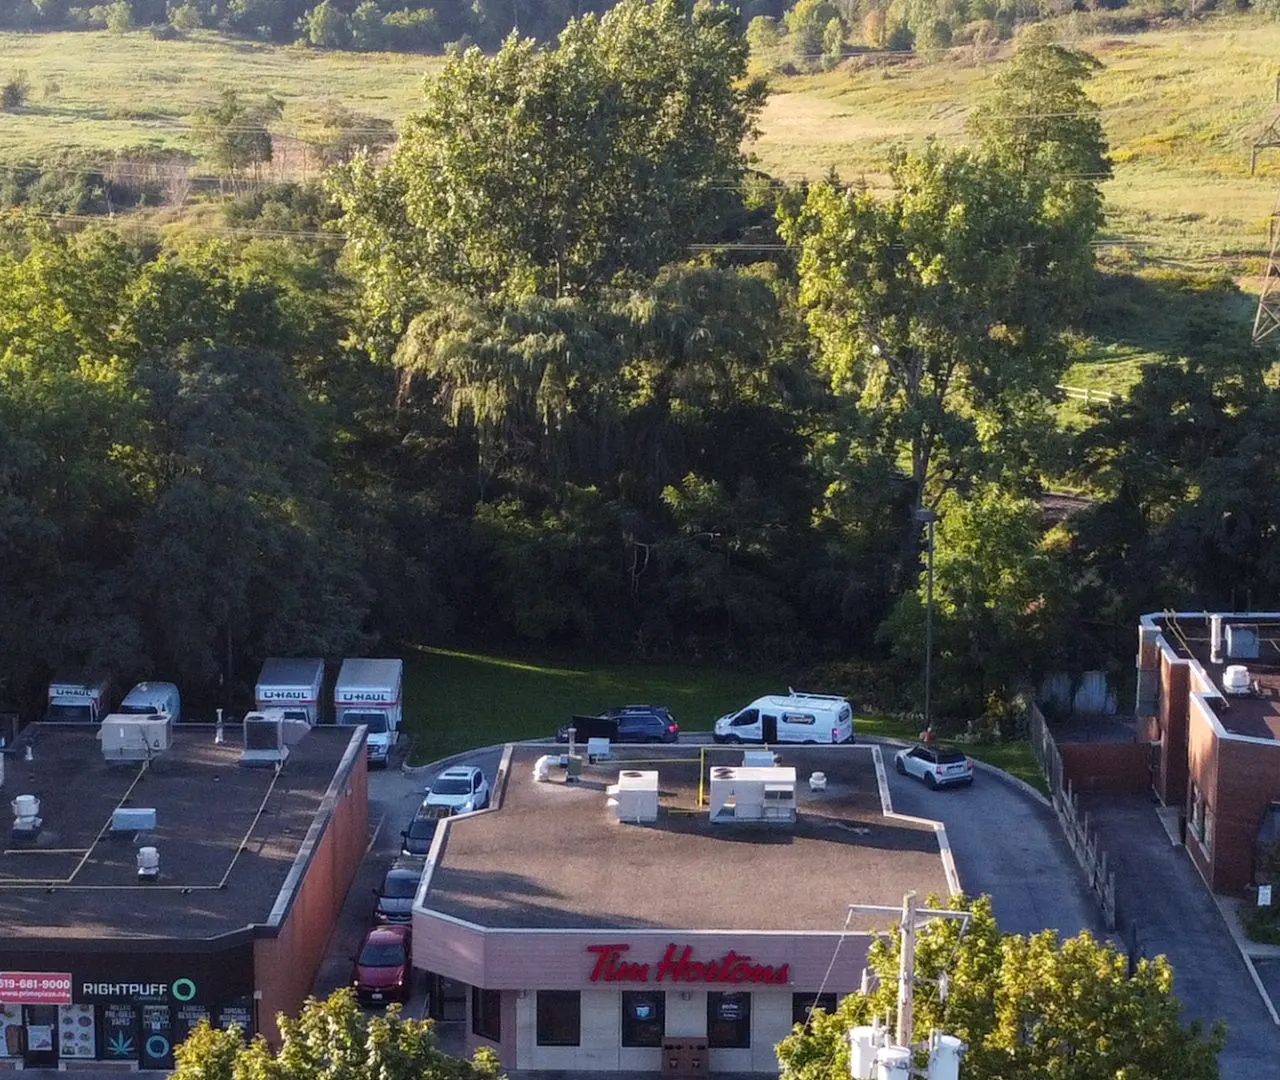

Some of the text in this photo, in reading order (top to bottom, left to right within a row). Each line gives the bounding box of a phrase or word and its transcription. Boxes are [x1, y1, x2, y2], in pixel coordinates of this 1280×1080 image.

[587, 943, 790, 984] Tim Hortons
[83, 983, 168, 995] RIGHTPUFF
